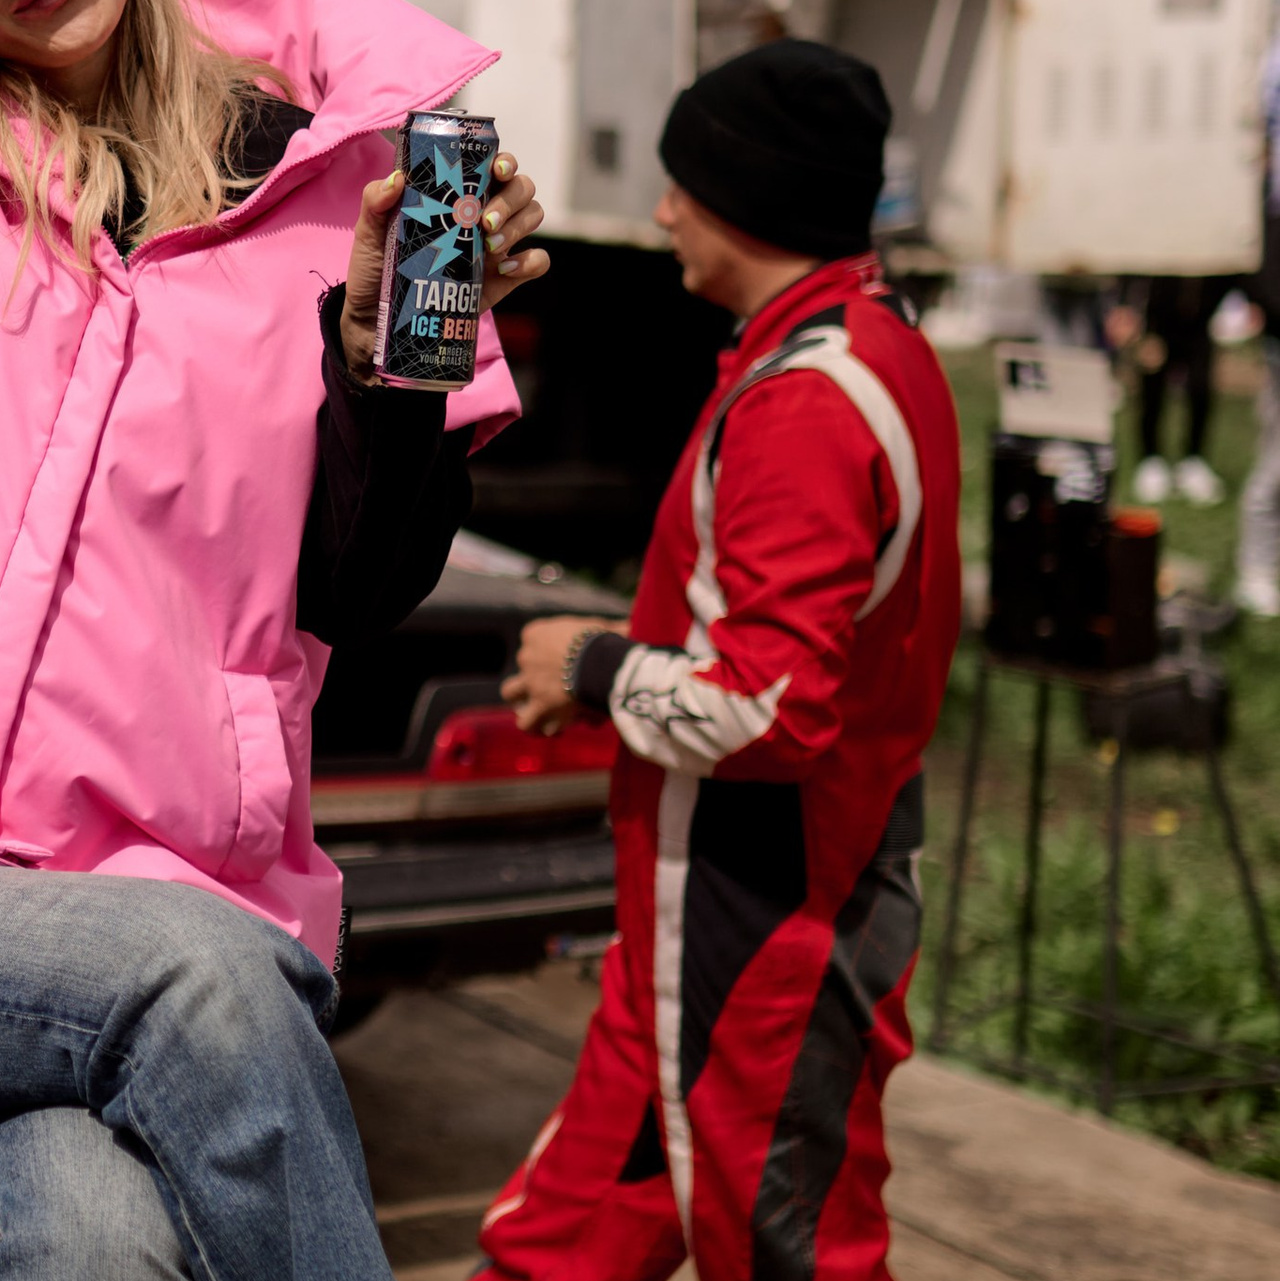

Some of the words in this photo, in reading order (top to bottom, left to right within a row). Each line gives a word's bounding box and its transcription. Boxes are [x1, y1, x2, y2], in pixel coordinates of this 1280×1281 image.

[413, 279, 483, 313] TARGET
[410, 315, 440, 338] ICE
[420, 354, 440, 365] YOUR
[441, 356, 462, 366] GOALS
[438, 346, 463, 357] TARGET
